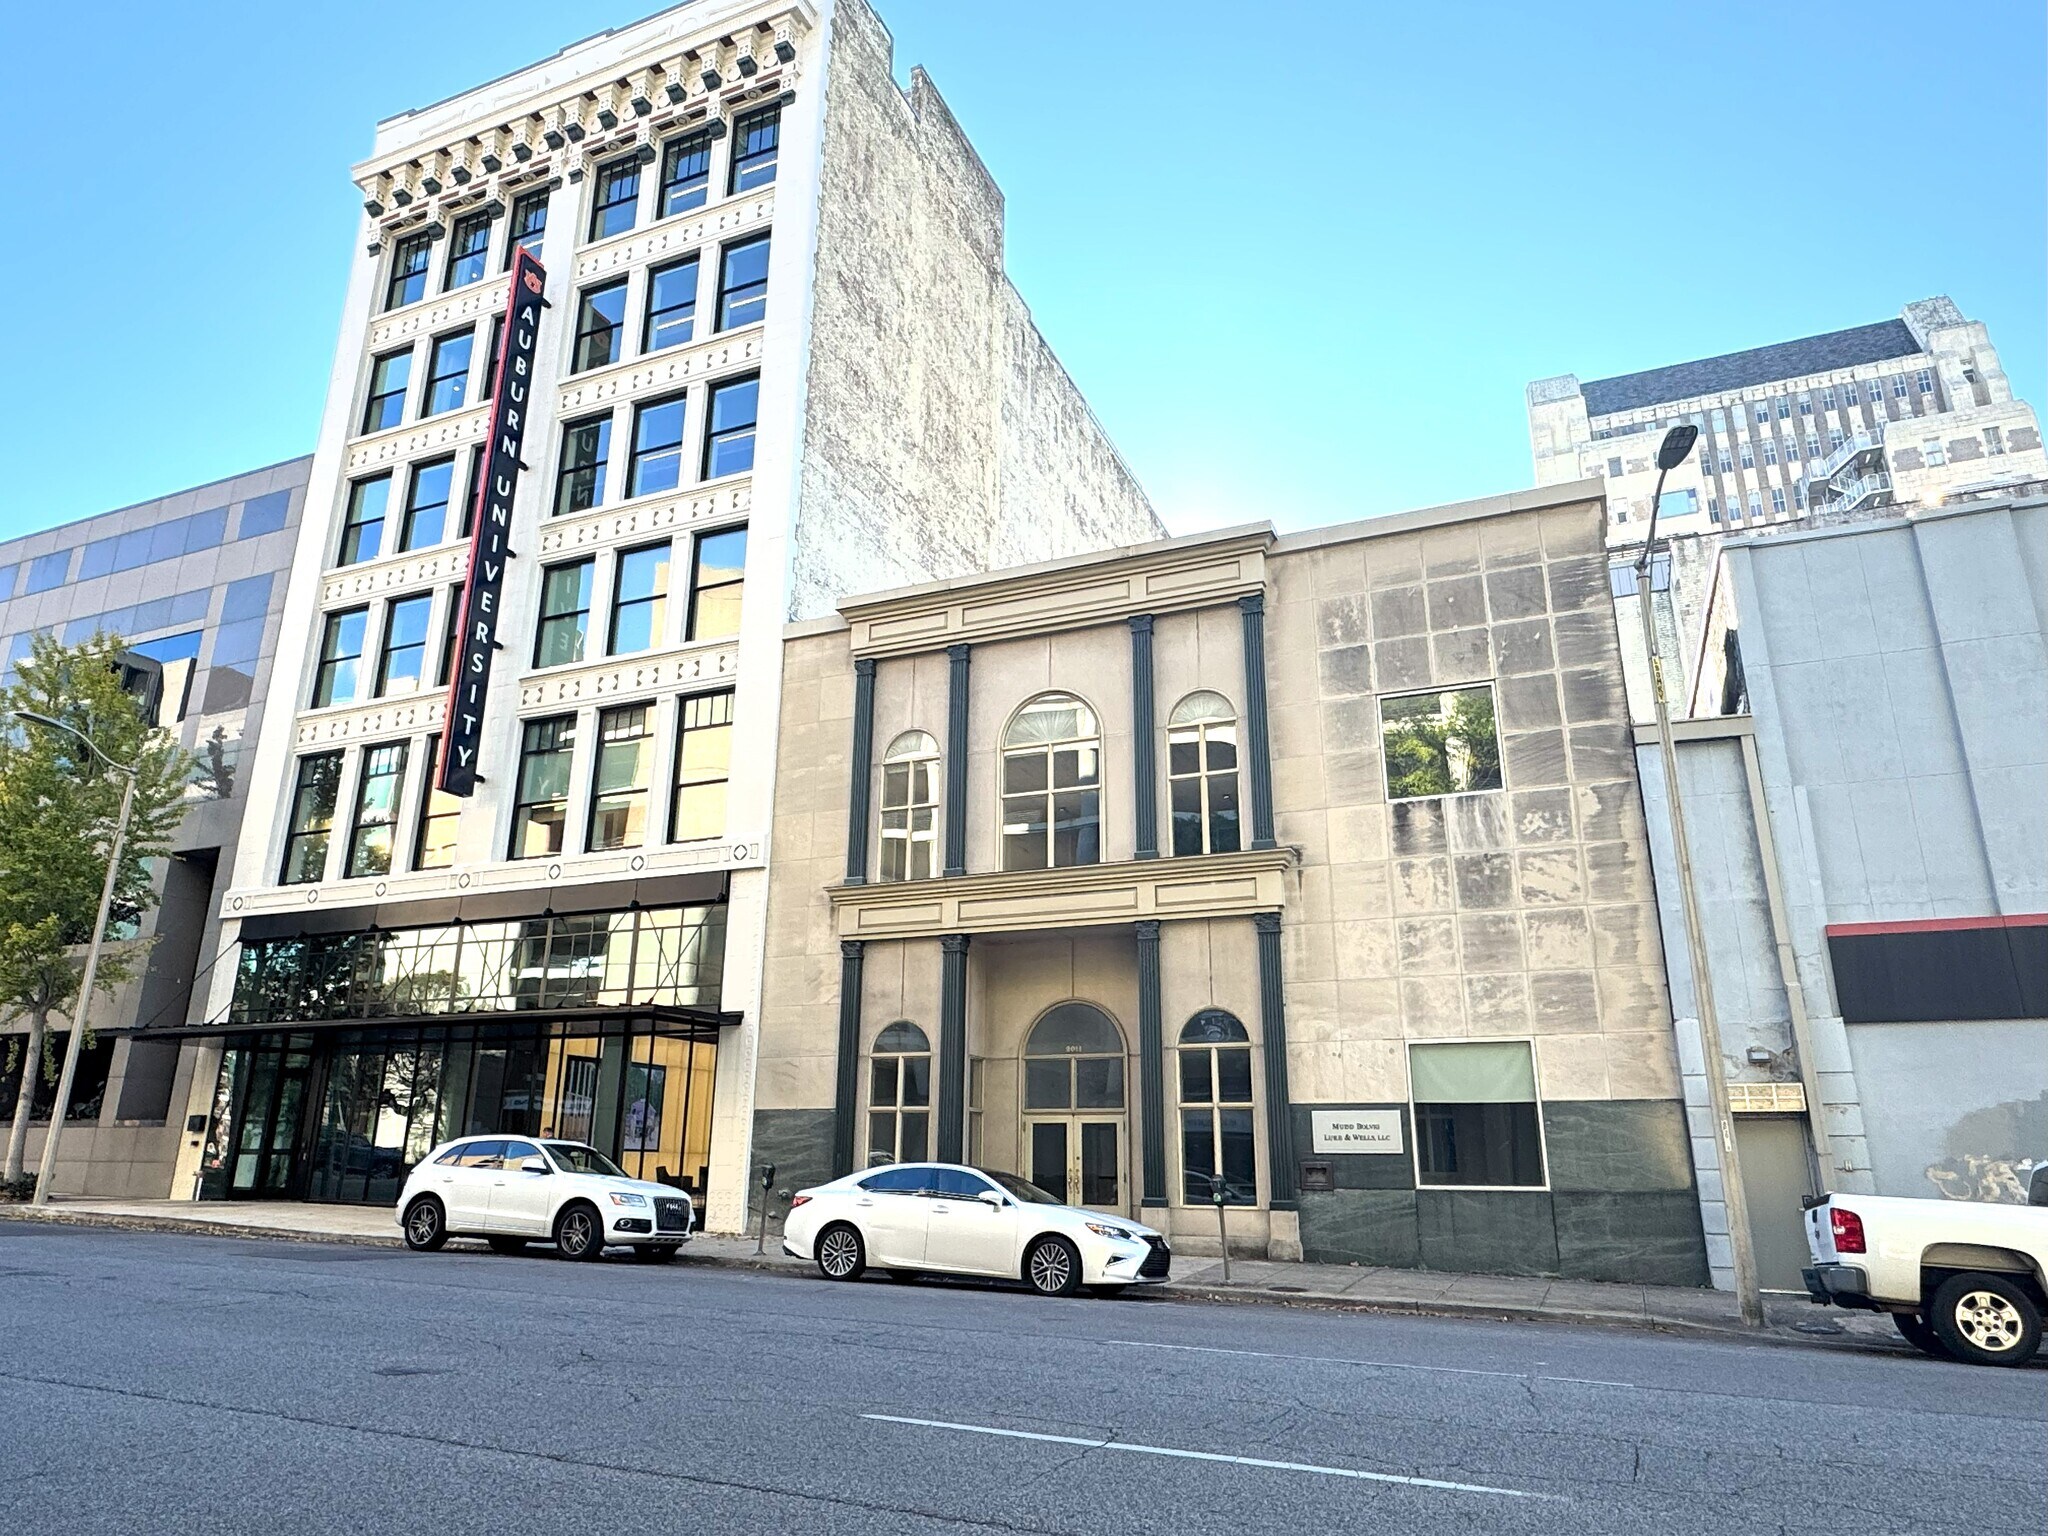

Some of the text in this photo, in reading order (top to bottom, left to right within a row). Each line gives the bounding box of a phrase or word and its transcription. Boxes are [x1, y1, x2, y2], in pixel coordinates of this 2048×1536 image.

[502, 306, 534, 458] AUBURN
[458, 475, 510, 768] UNIVERSITY
[1344, 1133, 1351, 1141] &
